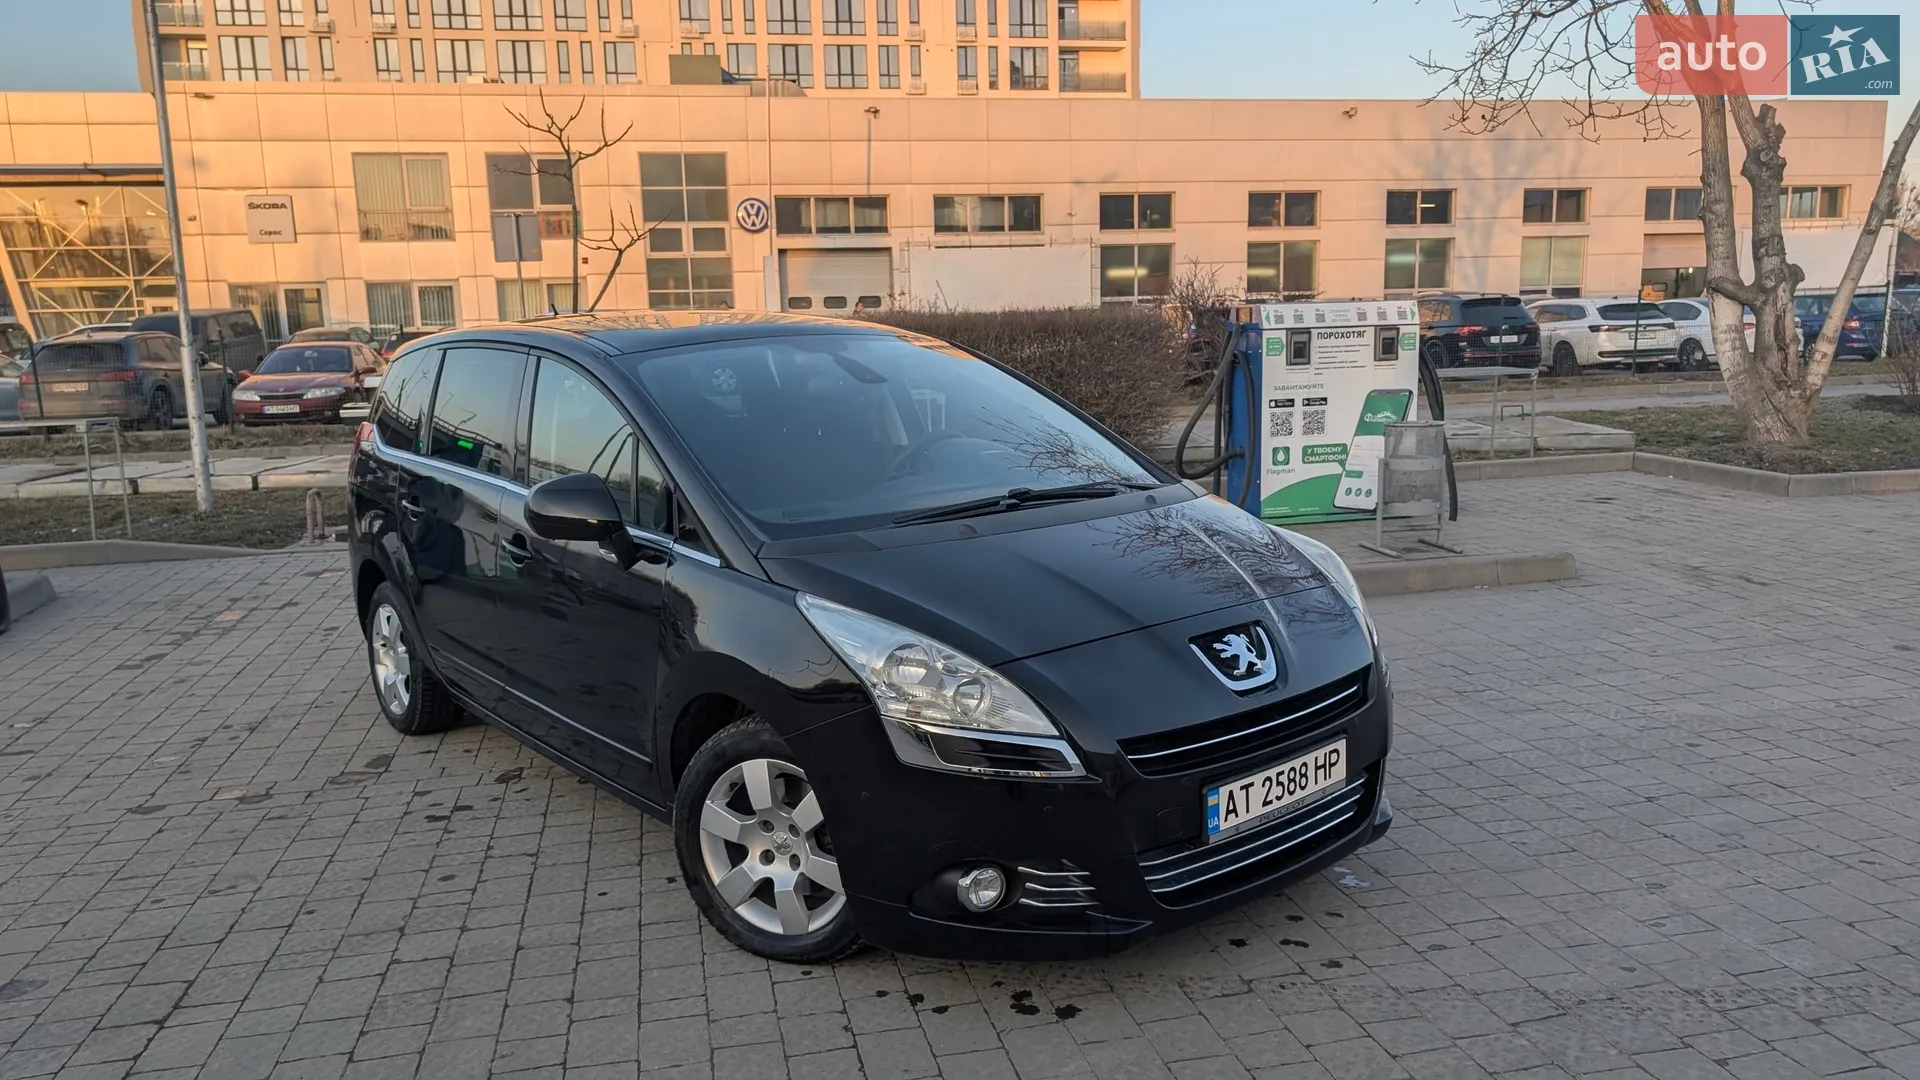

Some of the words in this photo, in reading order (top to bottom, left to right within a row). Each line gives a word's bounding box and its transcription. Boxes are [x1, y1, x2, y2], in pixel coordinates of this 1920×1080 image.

[1316, 330, 1367, 340] ПОРОХОТЯГ
[1273, 382, 1325, 391] ЗАВАНТАЖУЙТЕ
[1314, 446, 1342, 454] ТВОЄМУ
[1304, 454, 1347, 462] СМАРТФОНІ
[1266, 467, 1296, 475] Flagman
[1223, 781, 1255, 823] AT
[1261, 761, 1309, 808] 2588
[1314, 748, 1340, 785] HP
[1258, 799, 1306, 823] PEUGEOT
[1207, 816, 1219, 828] UA
